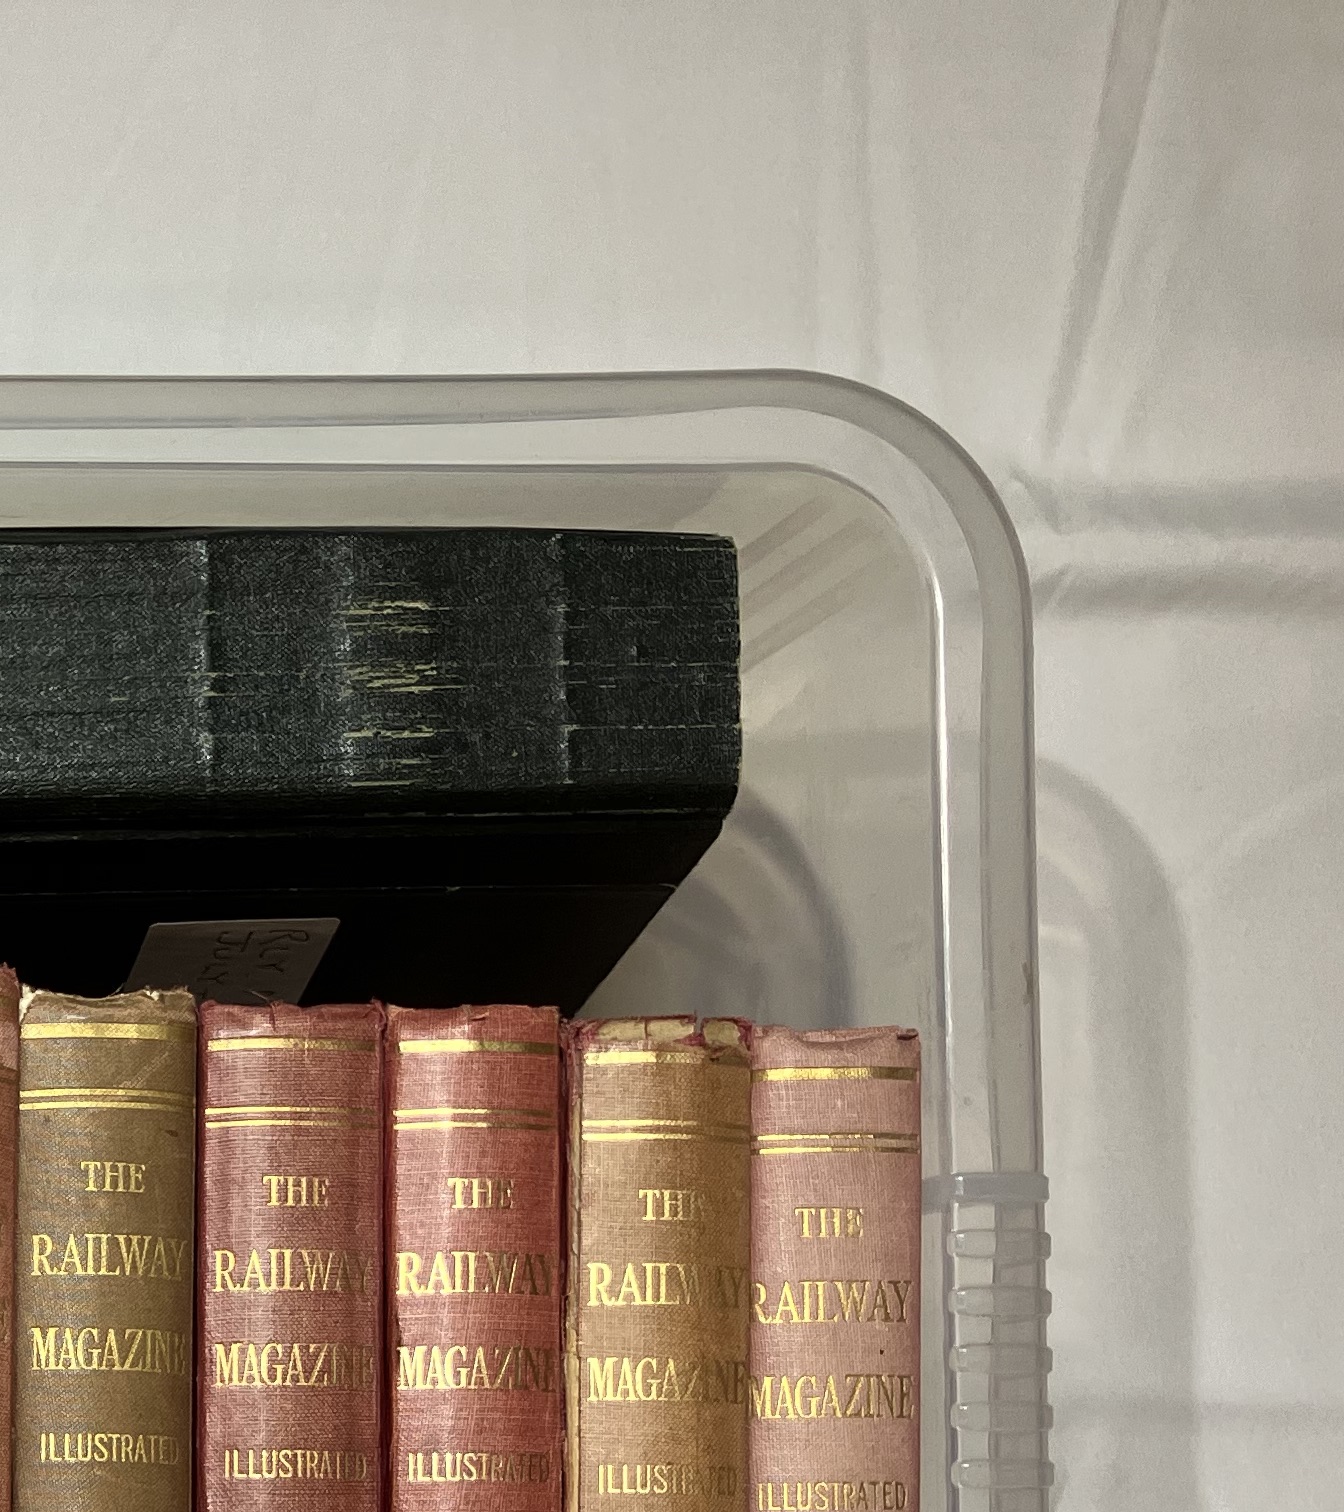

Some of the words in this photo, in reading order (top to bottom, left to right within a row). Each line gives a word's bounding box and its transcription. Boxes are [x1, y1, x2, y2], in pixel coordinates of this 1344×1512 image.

[80, 1161, 147, 1193] THE
[262, 1175, 330, 1209] THE
[447, 1176, 513, 1209] THE
[795, 1207, 864, 1239] THE
[30, 1233, 189, 1282] RAILWAY
[214, 1248, 372, 1296] RAILWAY
[396, 1250, 552, 1297] RAILWAY
[750, 1280, 912, 1325] RAILWAY
[30, 1327, 187, 1377] MAGAZINE
[397, 1345, 556, 1393] MAGAZINE
[748, 1374, 914, 1420] MAGAZINE
[40, 1432, 180, 1467] ILLUSTRATED
[758, 1481, 908, 1512] ILLUSTRATED
